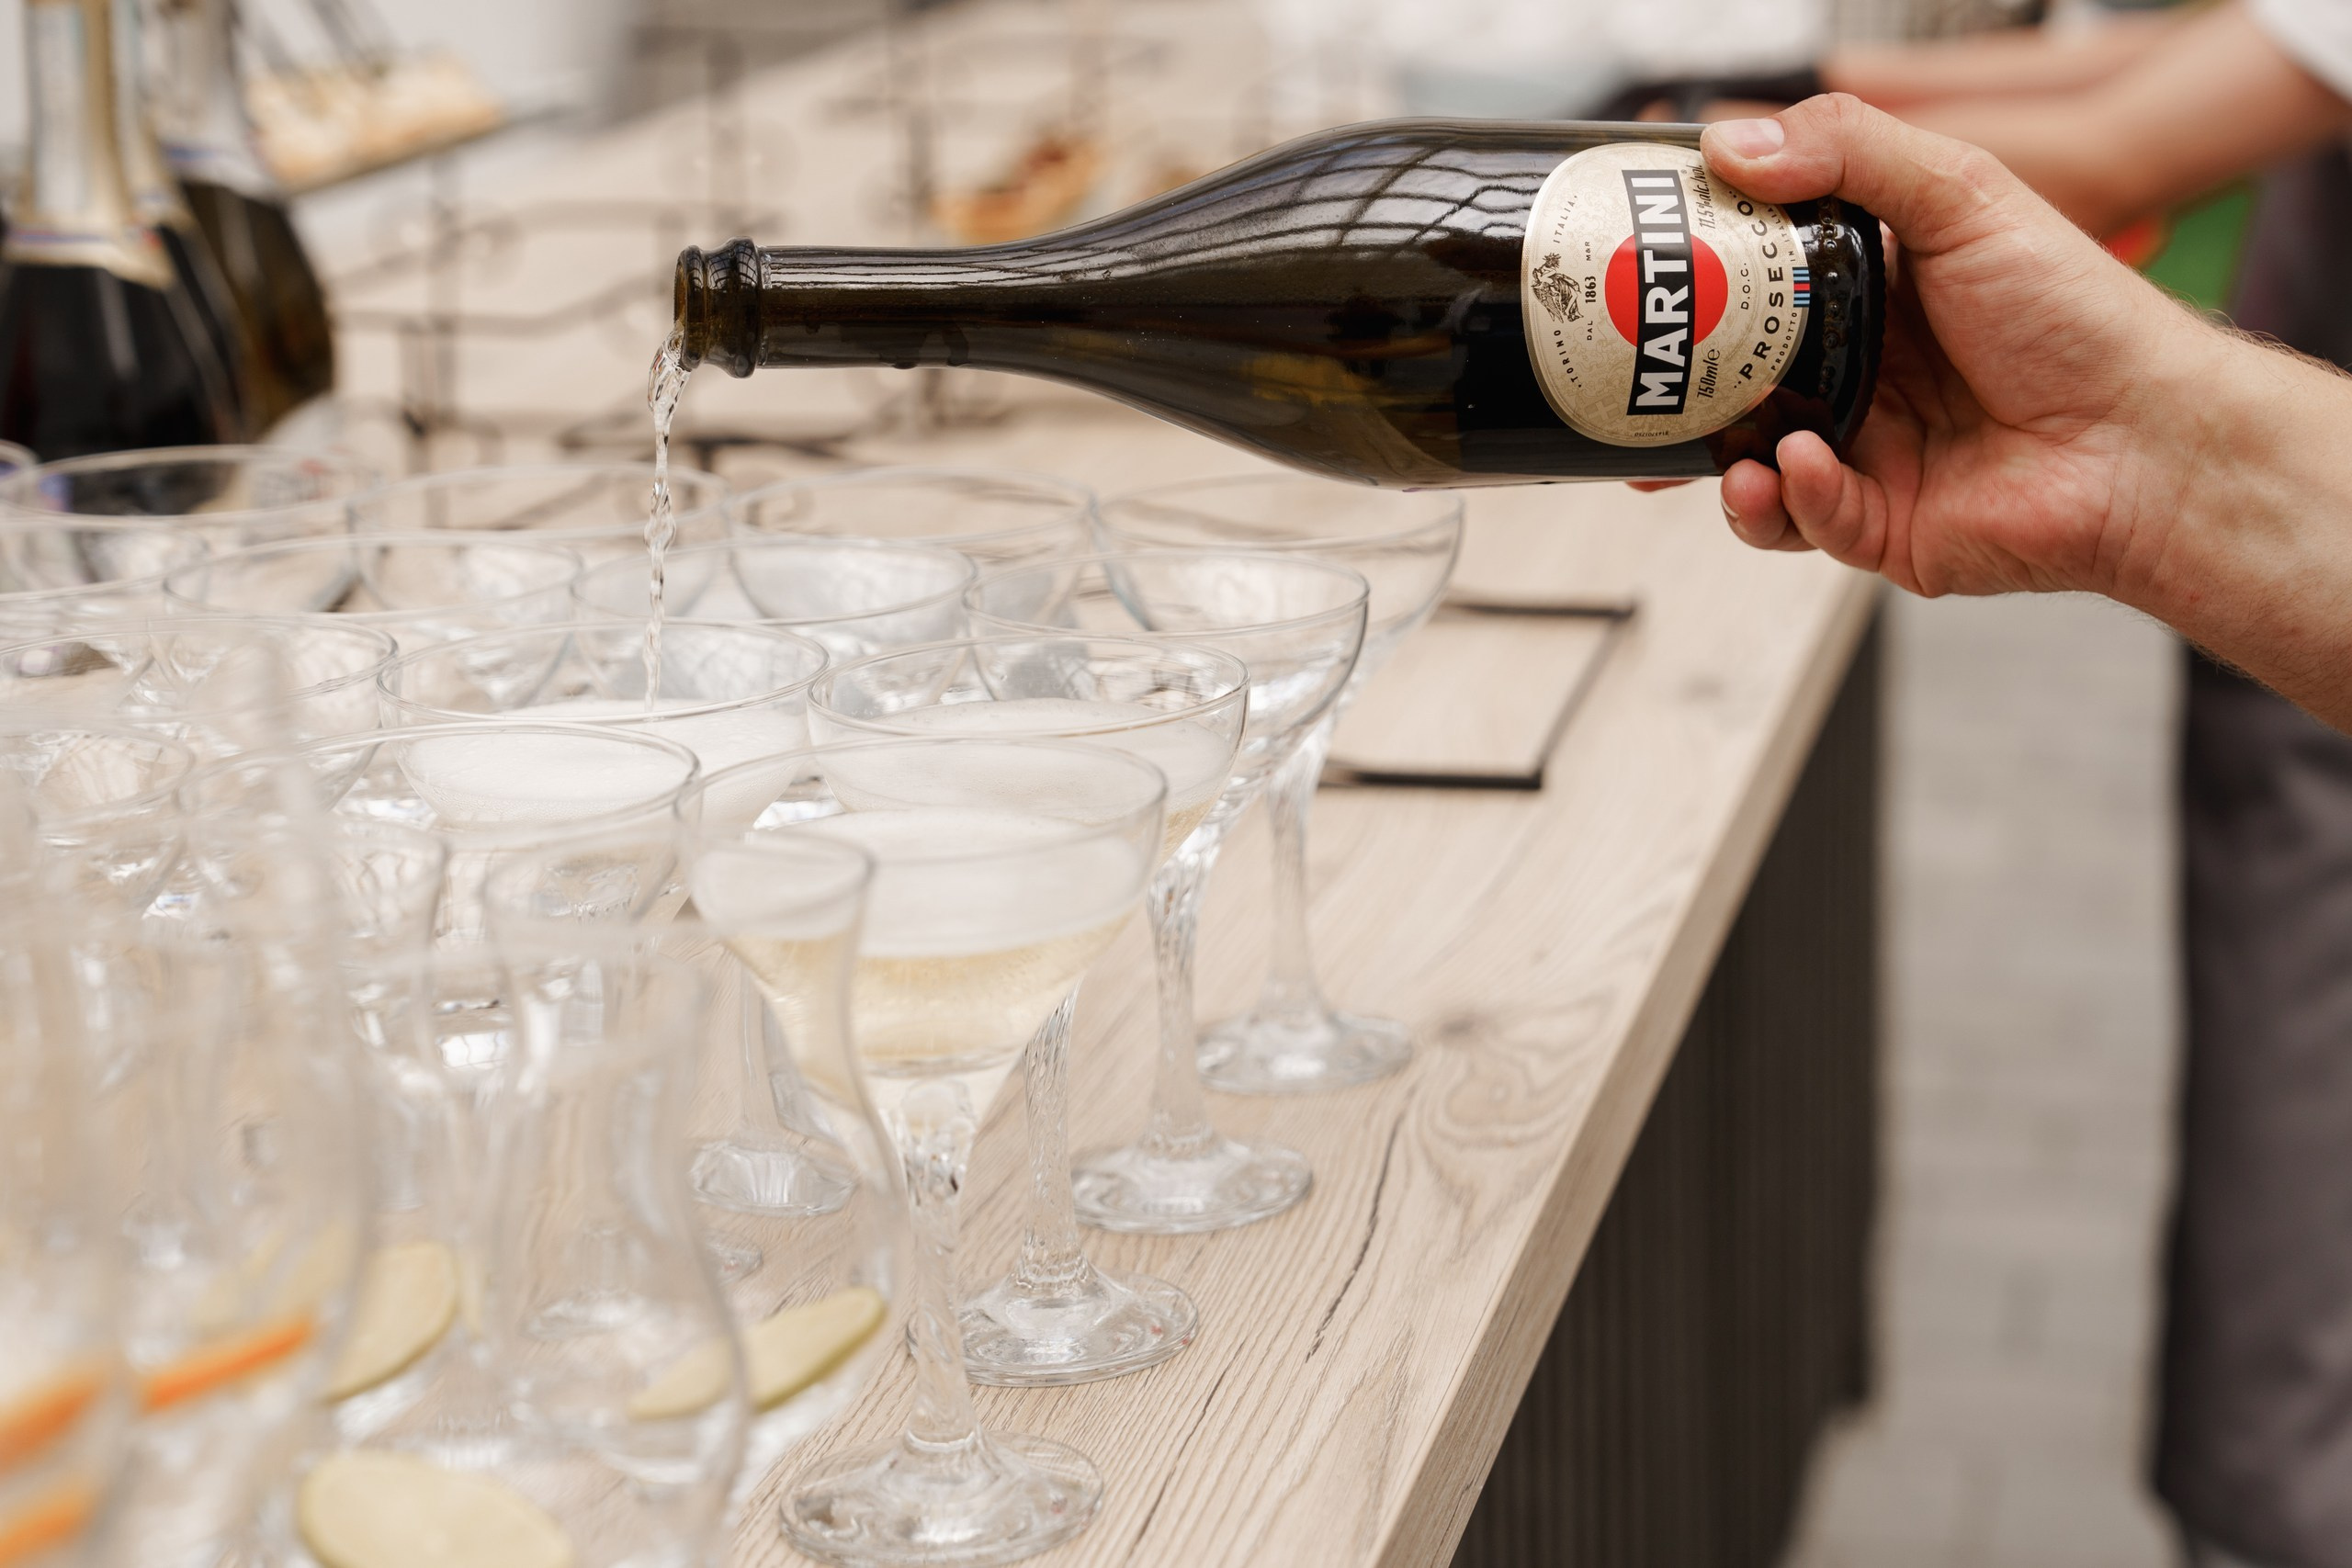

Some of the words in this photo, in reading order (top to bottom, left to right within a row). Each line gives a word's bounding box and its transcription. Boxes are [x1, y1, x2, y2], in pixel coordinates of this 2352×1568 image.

[1553, 199, 1576, 243] ITALIA
[1768, 207, 1790, 243] ITALIA
[1584, 242, 1592, 262] M&R
[1788, 251, 1796, 262] IN
[1585, 276, 1597, 304] 1863
[1631, 177, 1689, 406] MARTINI
[1736, 200, 1784, 380] PROSECCO
[1740, 263, 1751, 310] D.O.C.
[1554, 330, 1578, 383] TORINO
[1770, 312, 1798, 371] PRODOTTO
